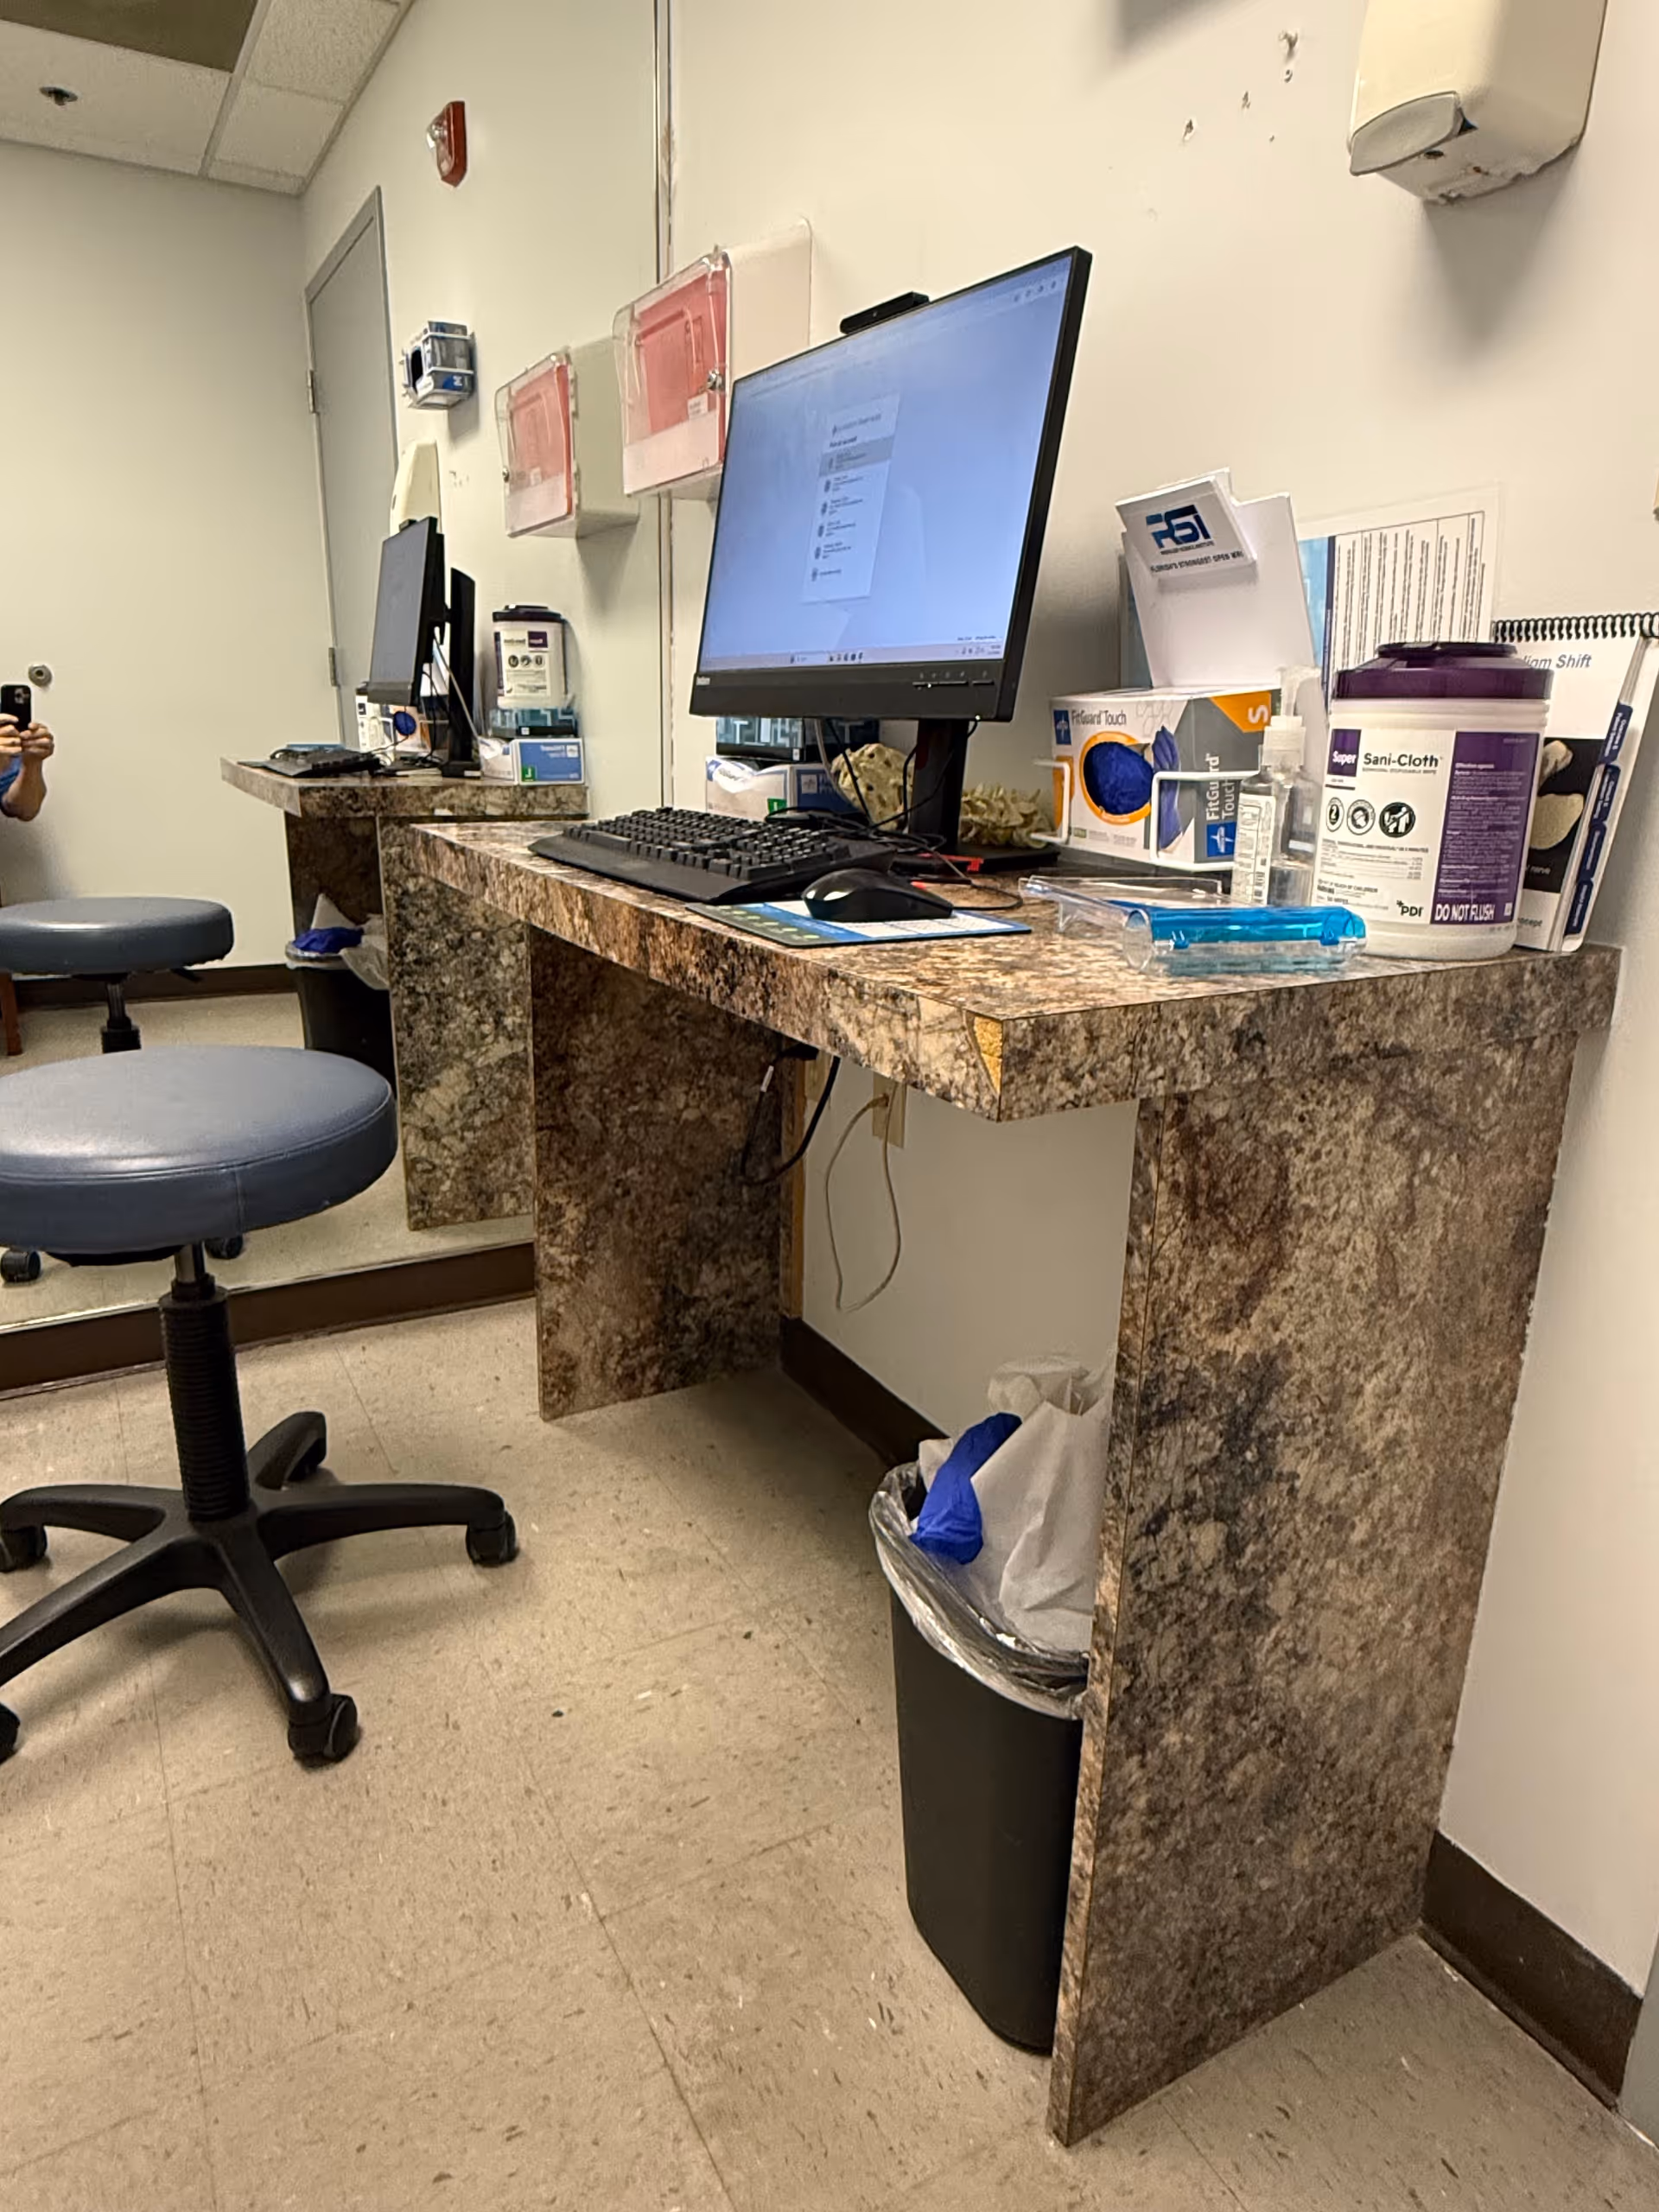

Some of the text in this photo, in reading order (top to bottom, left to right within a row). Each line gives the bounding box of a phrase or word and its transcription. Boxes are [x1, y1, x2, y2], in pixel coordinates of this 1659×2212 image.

[1556, 653, 1592, 669] Shift
[1071, 709, 1127, 726] FitGuard Touch
[1248, 704, 1269, 724] S
[1332, 750, 1357, 766] Super
[1363, 753, 1440, 768] Sani-Cloth
[1205, 756, 1220, 821] FitGurd
[1331, 804, 1337, 819] 2
[1434, 904, 1496, 920] DO NOT FLUSH
